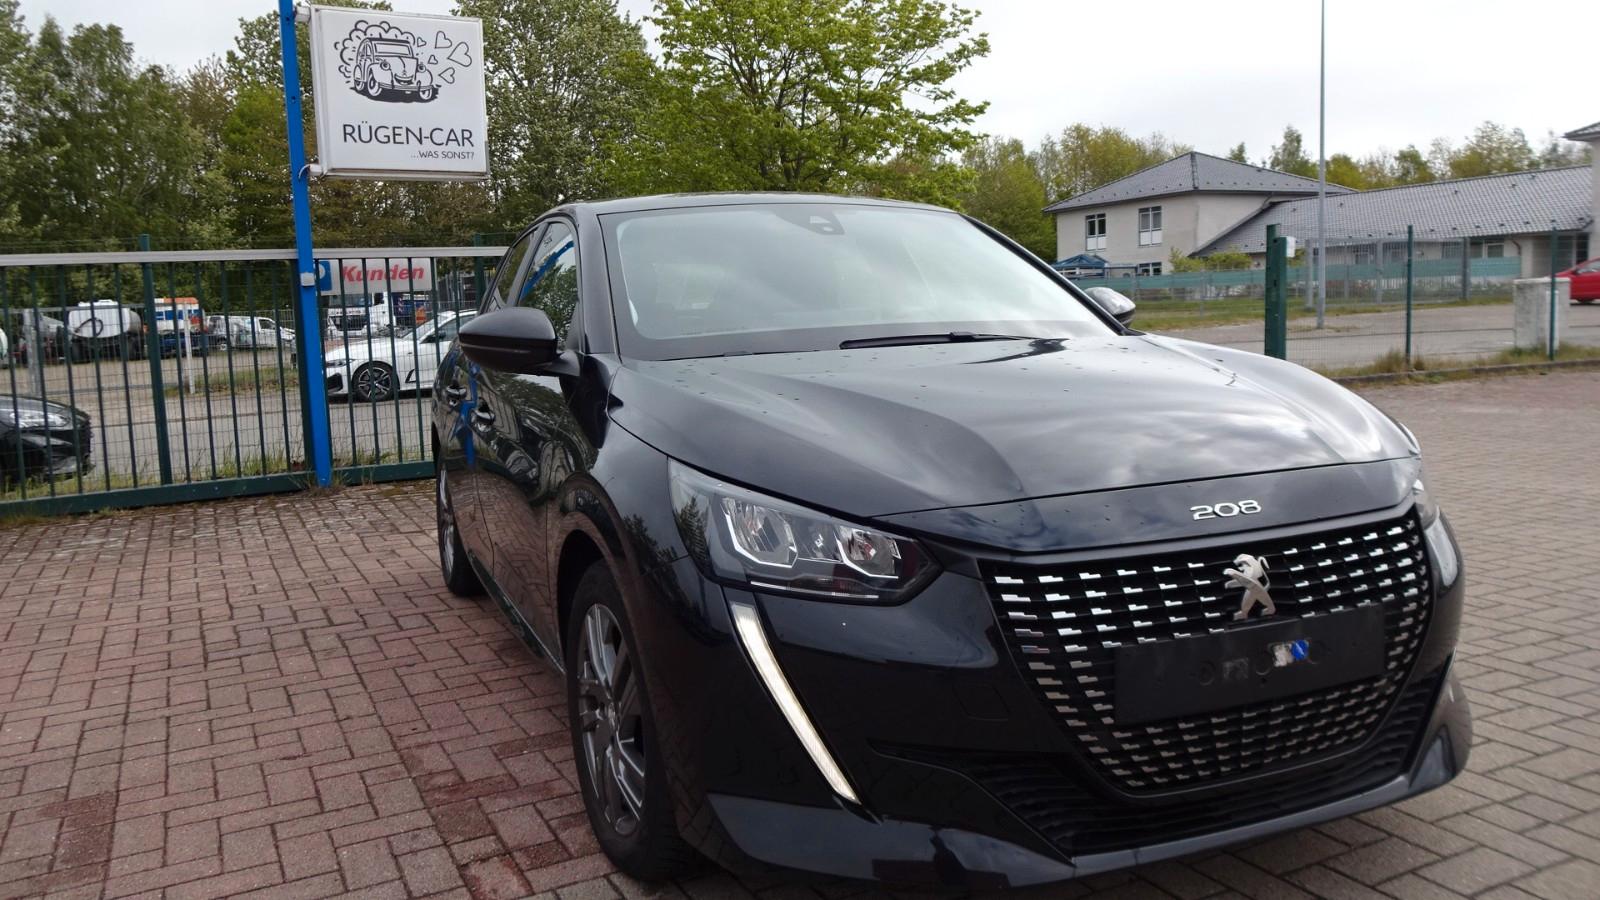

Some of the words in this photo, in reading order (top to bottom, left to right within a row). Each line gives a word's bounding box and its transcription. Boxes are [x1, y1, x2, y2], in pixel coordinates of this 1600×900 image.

[342, 120, 475, 148] RÜGEN-CAR
[441, 151, 475, 160] SONST?
[342, 264, 425, 282] Kunden
[1190, 499, 1262, 521] 208
